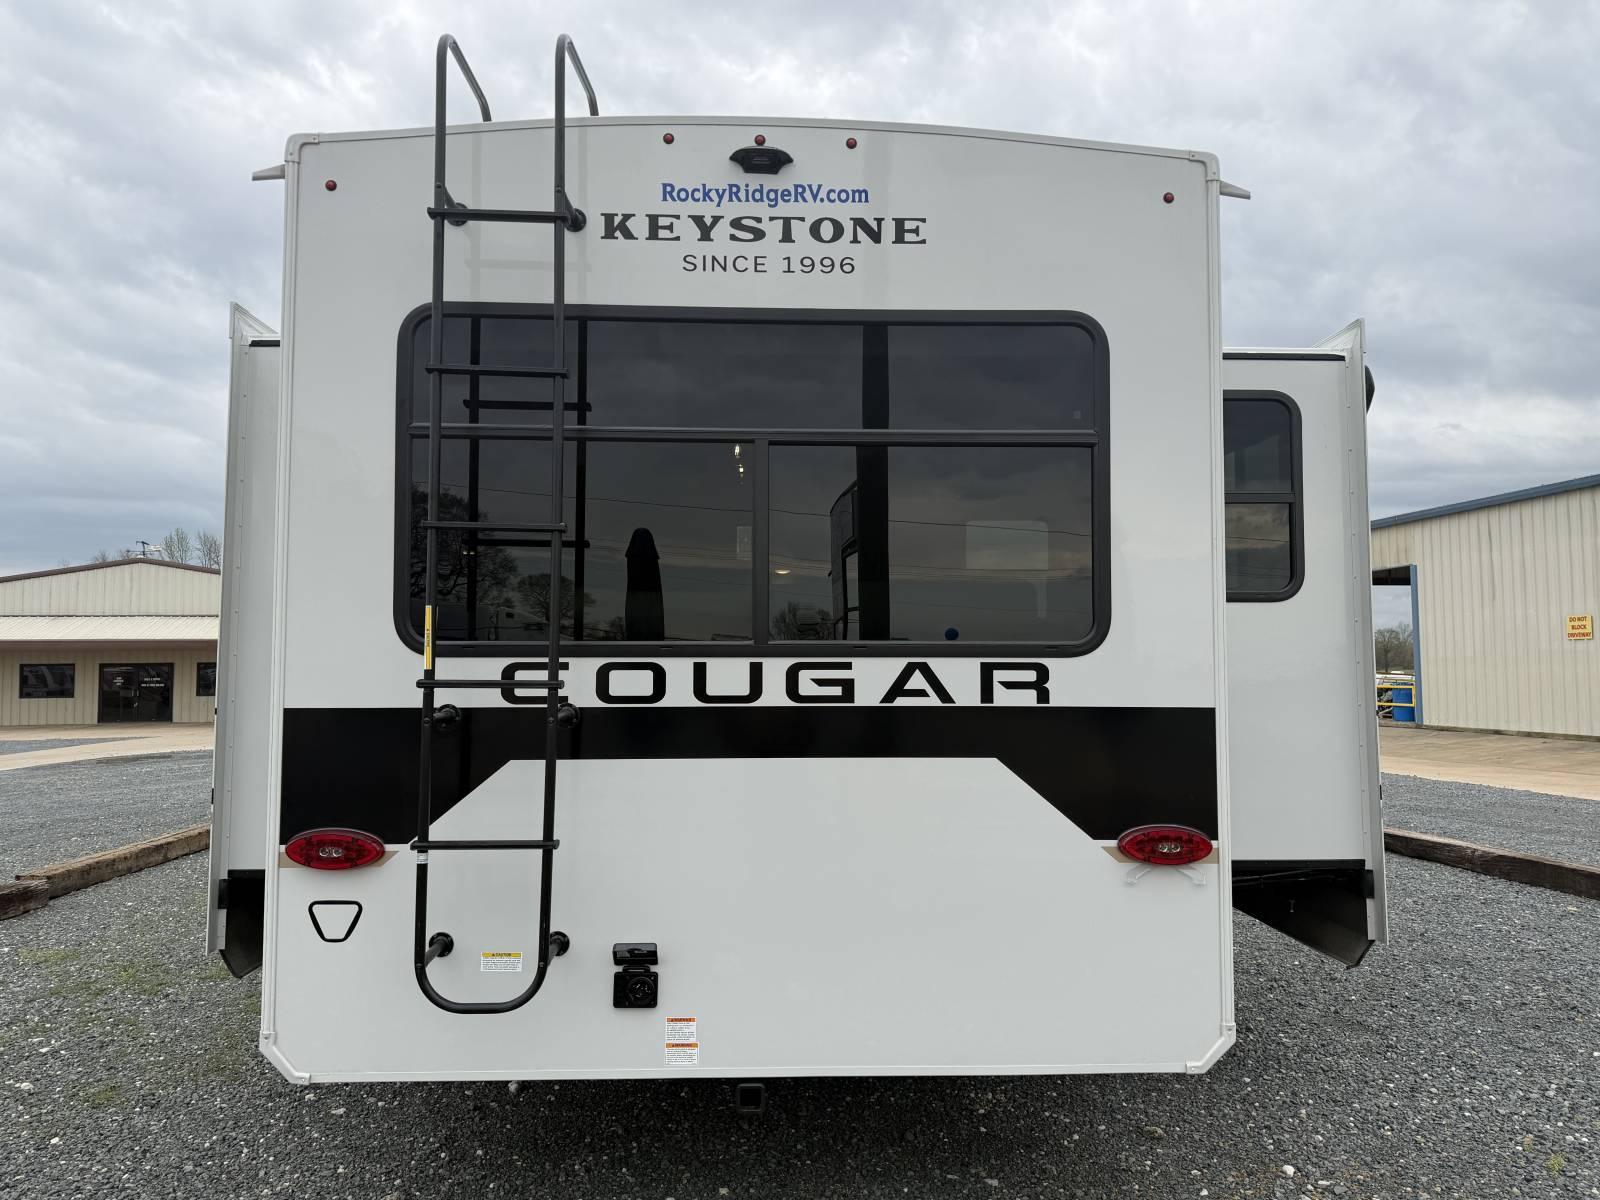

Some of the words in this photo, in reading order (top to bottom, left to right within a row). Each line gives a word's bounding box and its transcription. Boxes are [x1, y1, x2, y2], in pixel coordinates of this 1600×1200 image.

[660, 183, 870, 207] RockyRidgeRV.com
[600, 212, 927, 245] KEYSTONE
[682, 254, 768, 273] SINCE
[781, 256, 856, 274] 1996
[500, 661, 1050, 704] COUGAR
